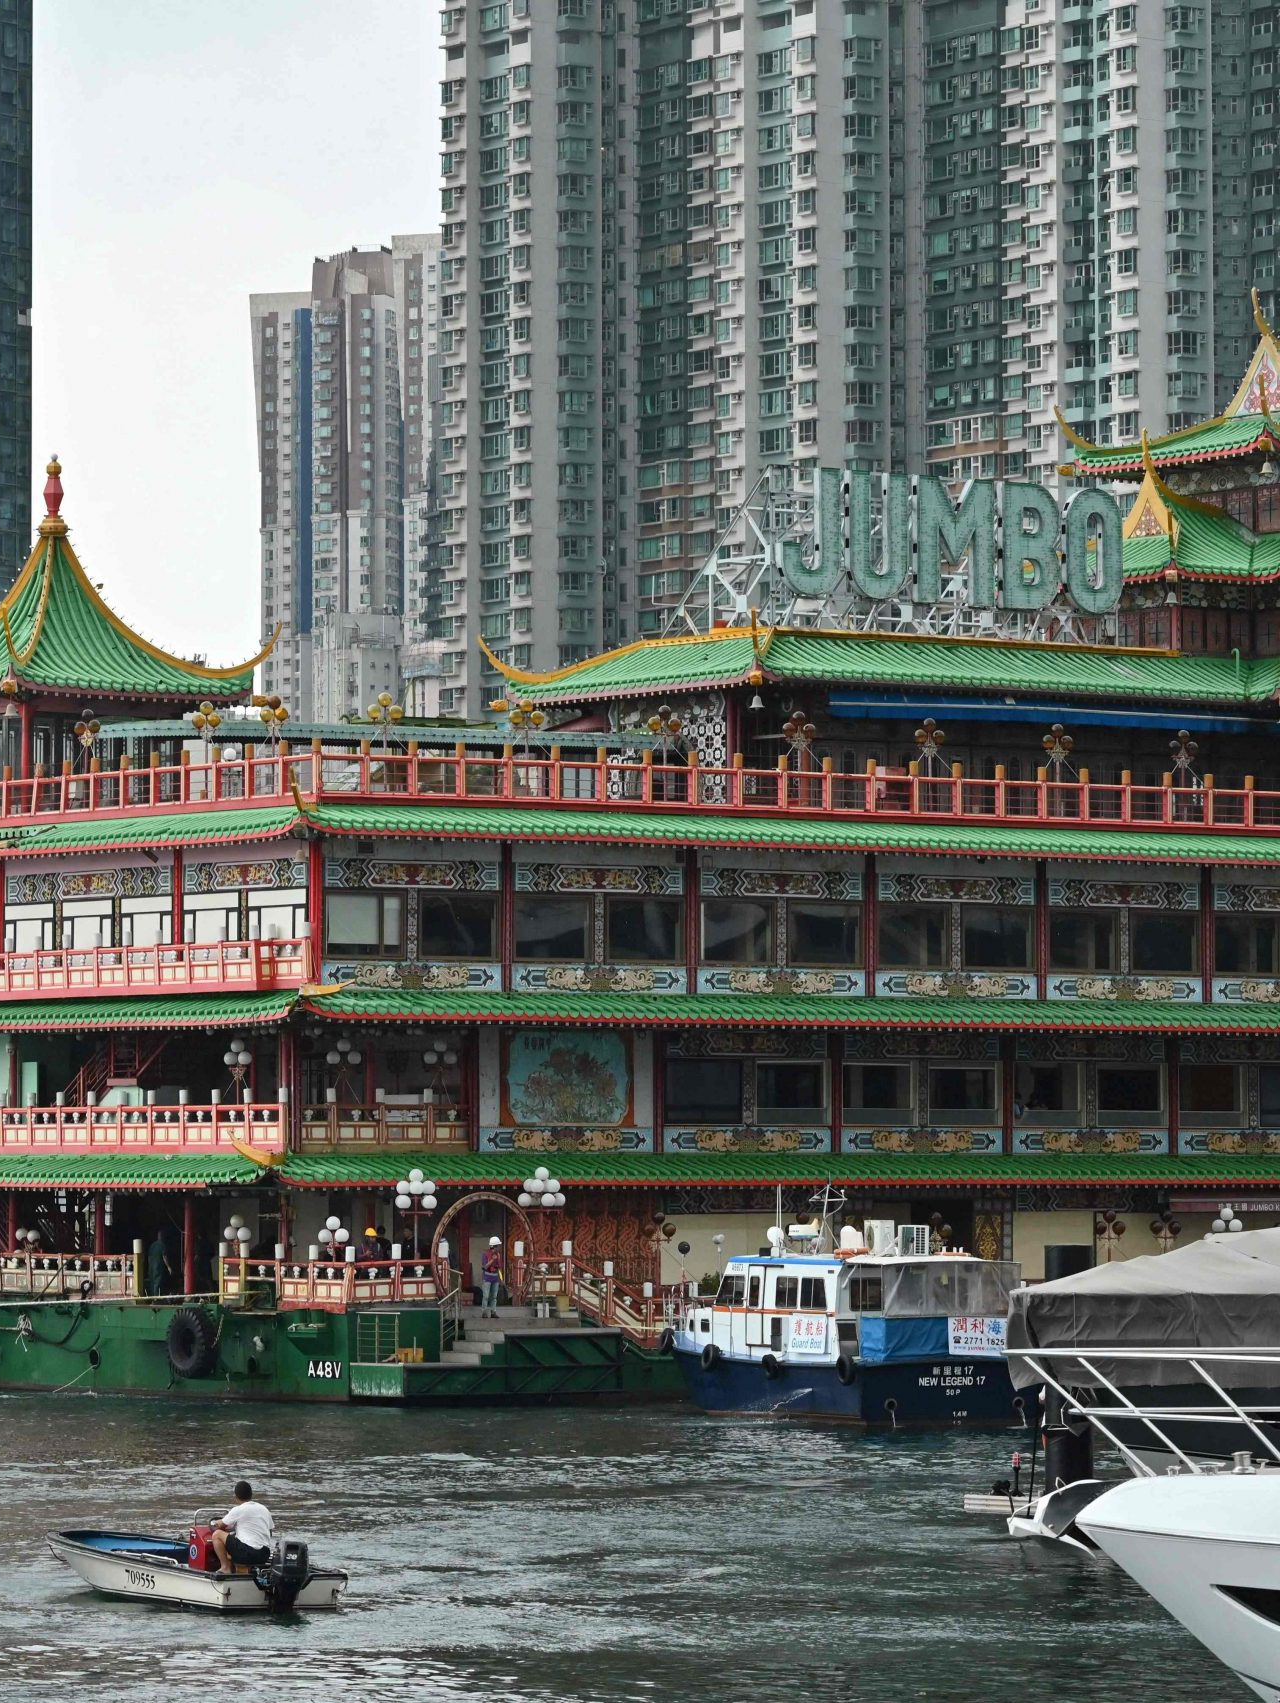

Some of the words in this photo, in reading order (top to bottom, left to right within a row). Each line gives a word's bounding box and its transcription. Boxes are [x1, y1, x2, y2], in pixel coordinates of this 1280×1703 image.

[775, 467, 1124, 614] JUMBO
[1250, 1203, 1274, 1211] JUMBO
[953, 1318, 1008, 1335] 潤利海
[791, 1337, 809, 1349] Guard
[964, 1336, 983, 1345] 2771
[986, 1337, 1005, 1346] 1825
[308, 1360, 342, 1379] A48V
[964, 1365, 974, 1376] 17
[918, 1377, 939, 1387] NEW
[940, 1376, 974, 1387] LEGEND
[976, 1376, 986, 1387] 17
[125, 1568, 156, 1591] 709555
